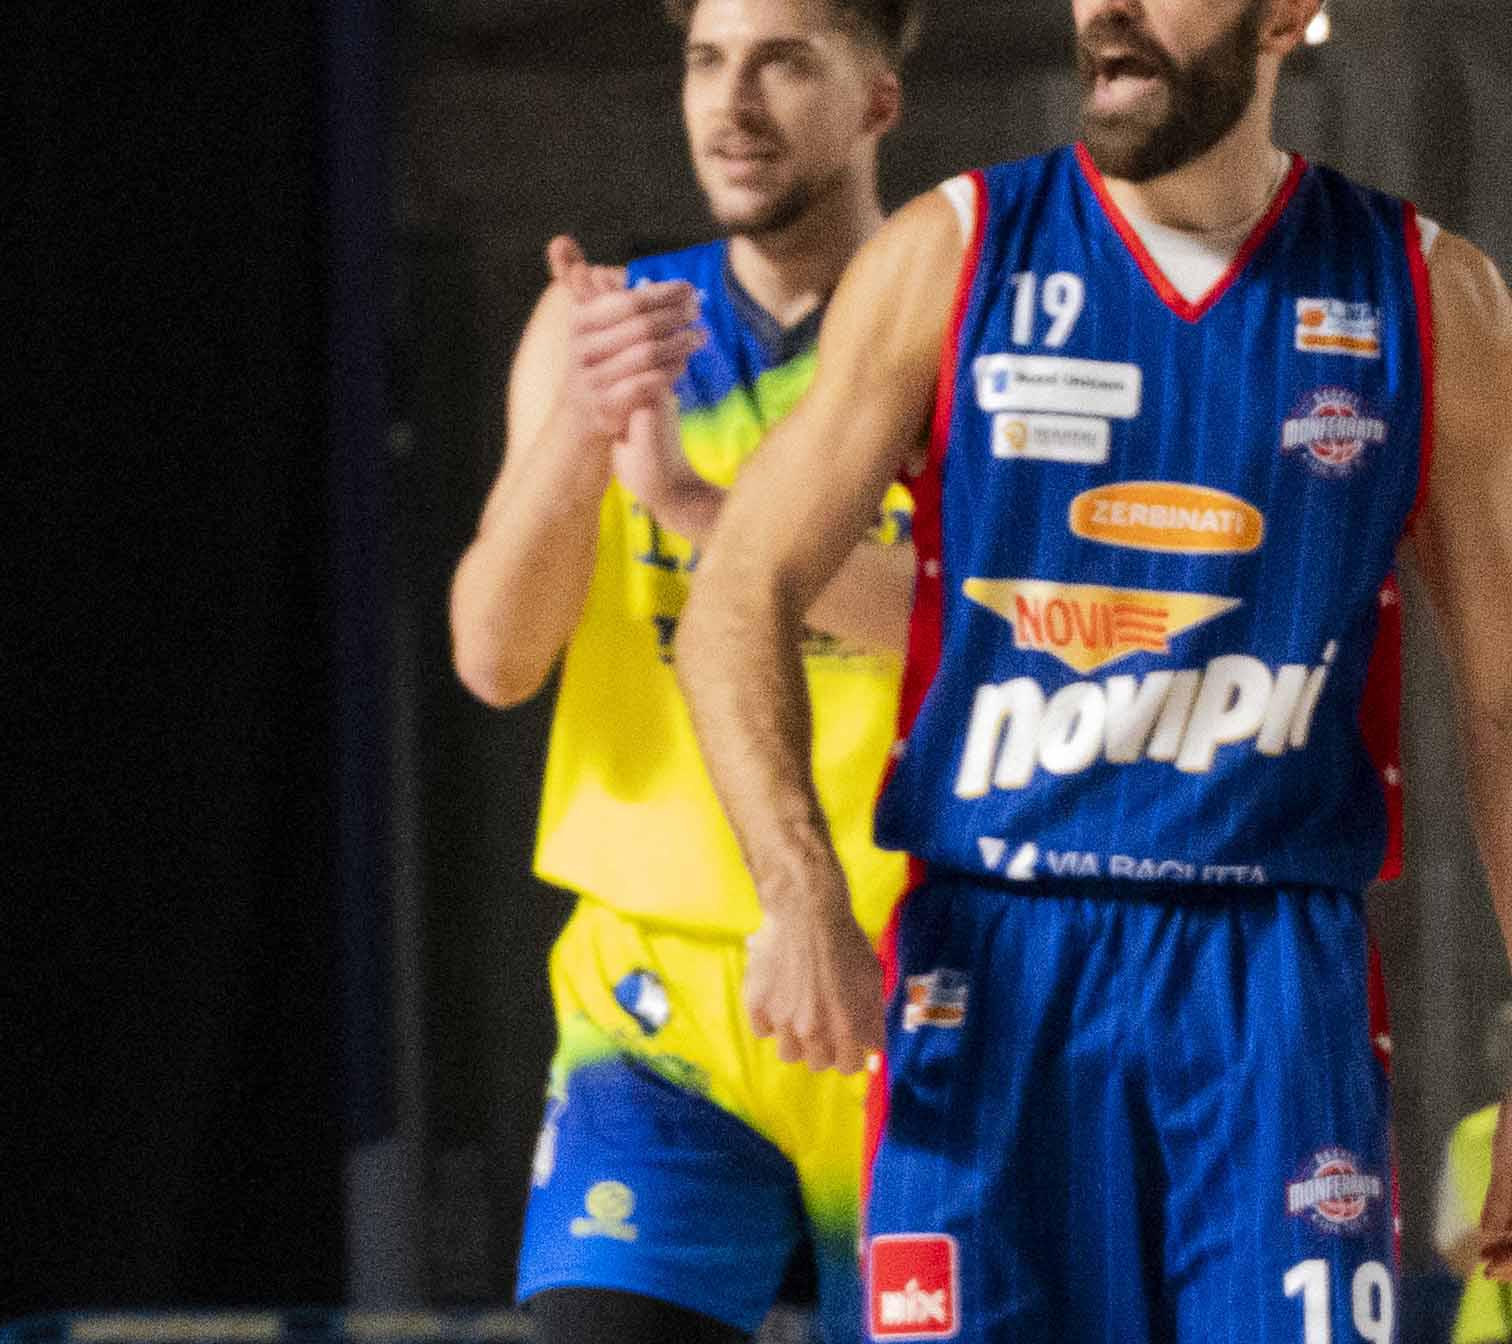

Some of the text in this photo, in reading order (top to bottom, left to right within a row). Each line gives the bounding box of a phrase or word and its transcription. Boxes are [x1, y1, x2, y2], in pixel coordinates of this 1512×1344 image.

[1011, 270, 1085, 347] 19
[1090, 499, 1247, 535] ZERBINATI
[1045, 849, 1101, 878] VIA
